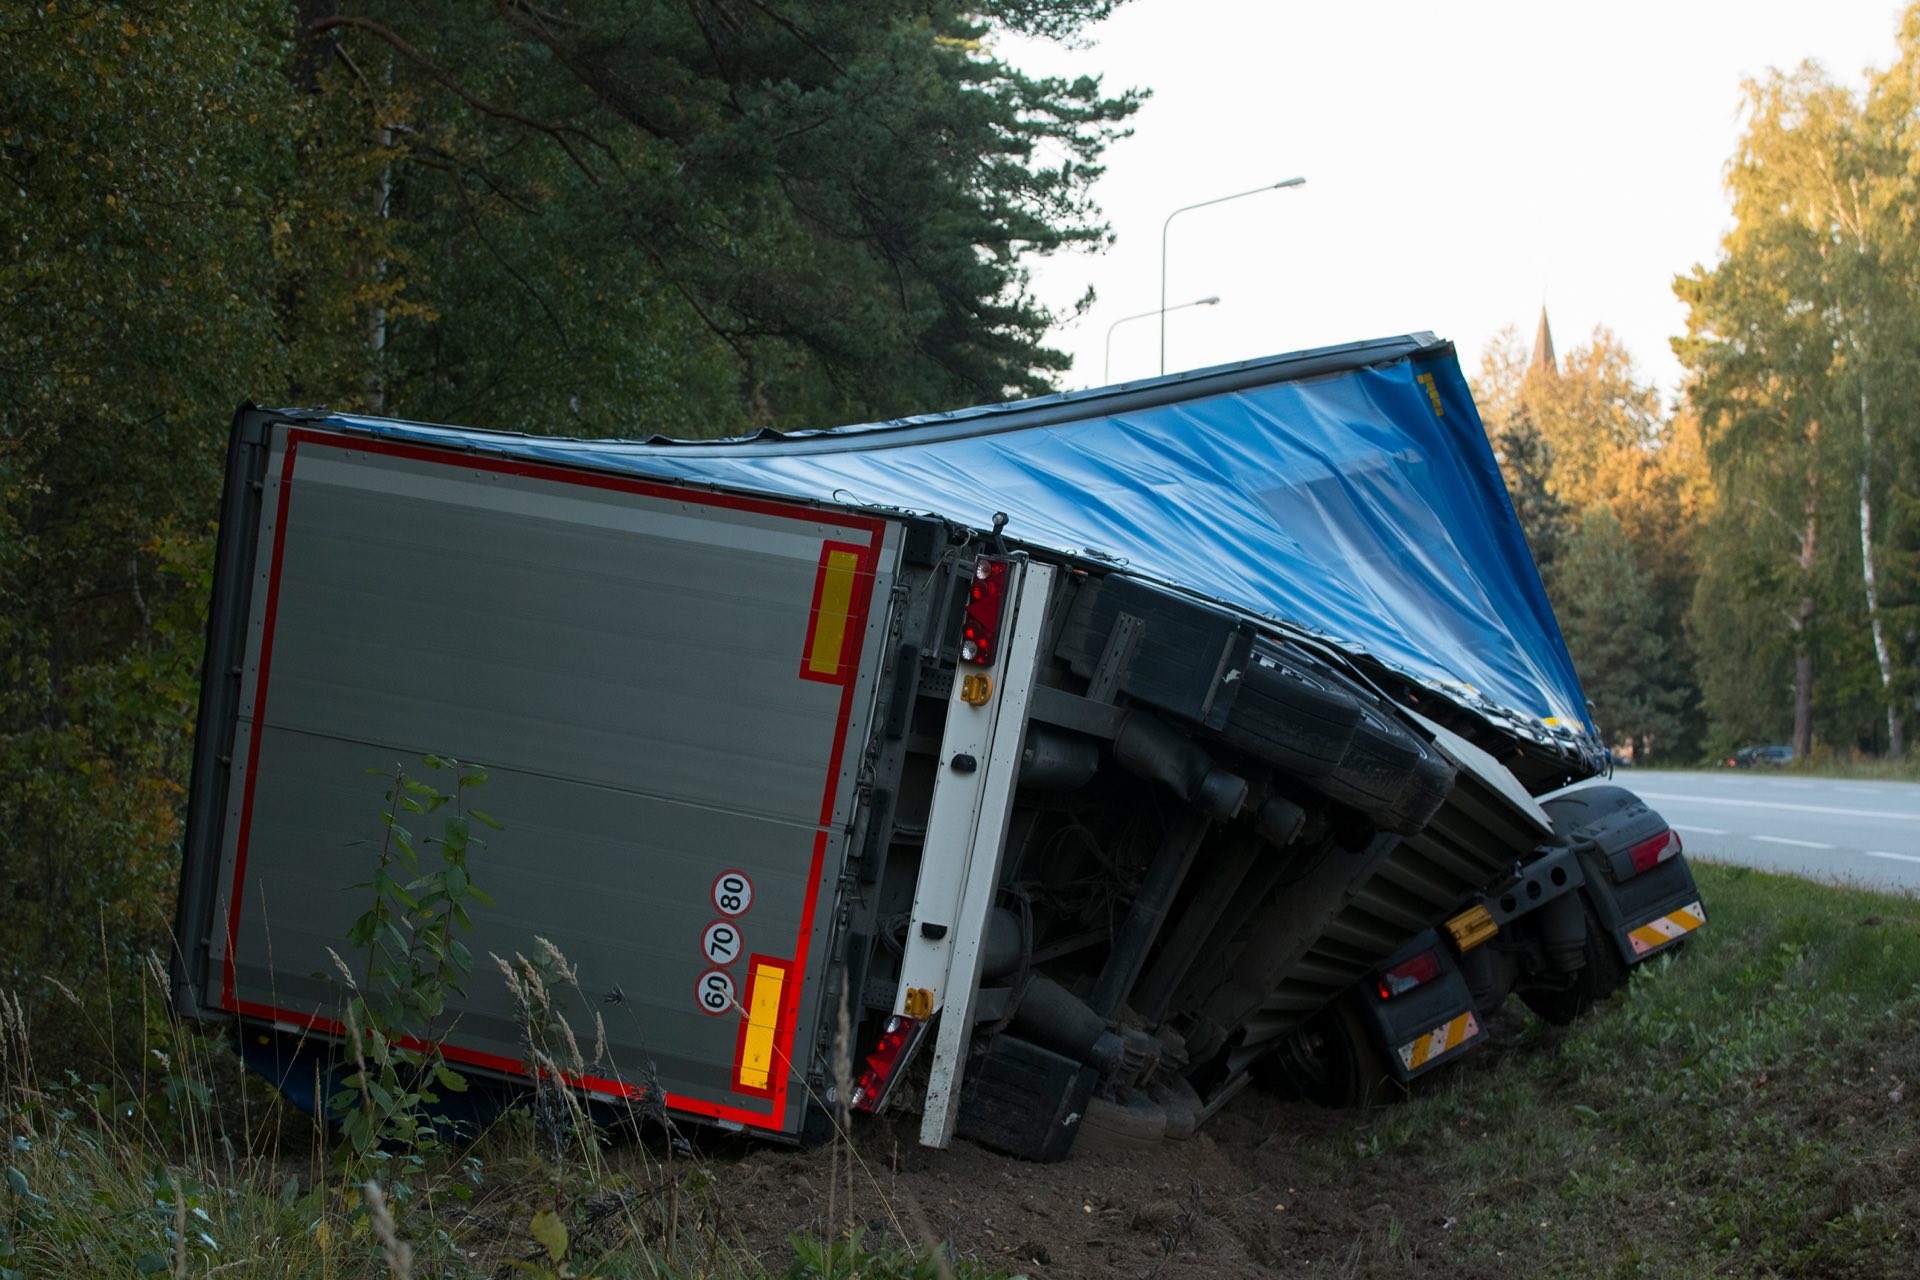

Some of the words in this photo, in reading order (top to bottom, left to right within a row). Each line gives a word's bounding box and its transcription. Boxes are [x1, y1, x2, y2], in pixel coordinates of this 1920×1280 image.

[720, 877, 744, 911] 80
[710, 928, 734, 956] 70
[704, 975, 728, 1009] 60
